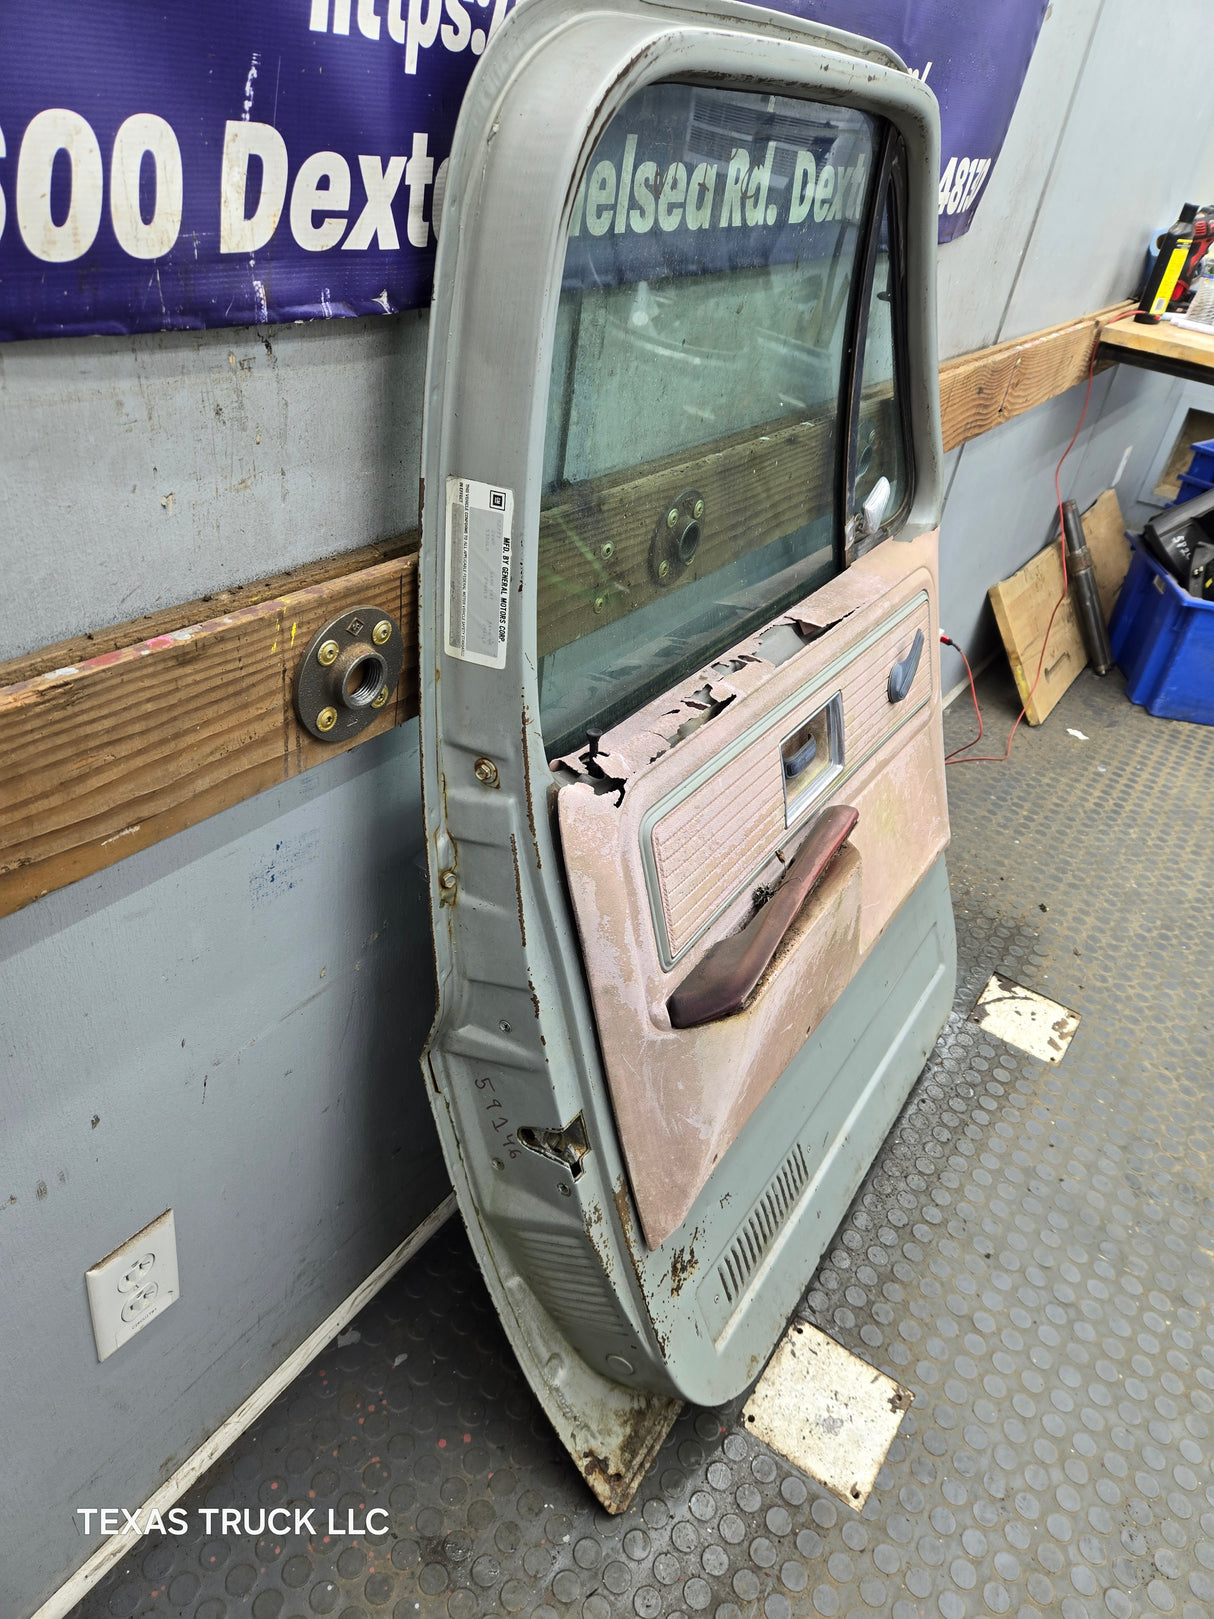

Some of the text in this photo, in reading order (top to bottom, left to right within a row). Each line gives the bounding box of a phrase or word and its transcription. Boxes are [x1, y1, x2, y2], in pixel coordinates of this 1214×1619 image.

[0, 107, 184, 263] 00
[720, 141, 777, 228] Rd.
[502, 555, 510, 566] BY
[501, 566, 509, 595] GENERAL
[498, 625, 506, 643] CORP.
